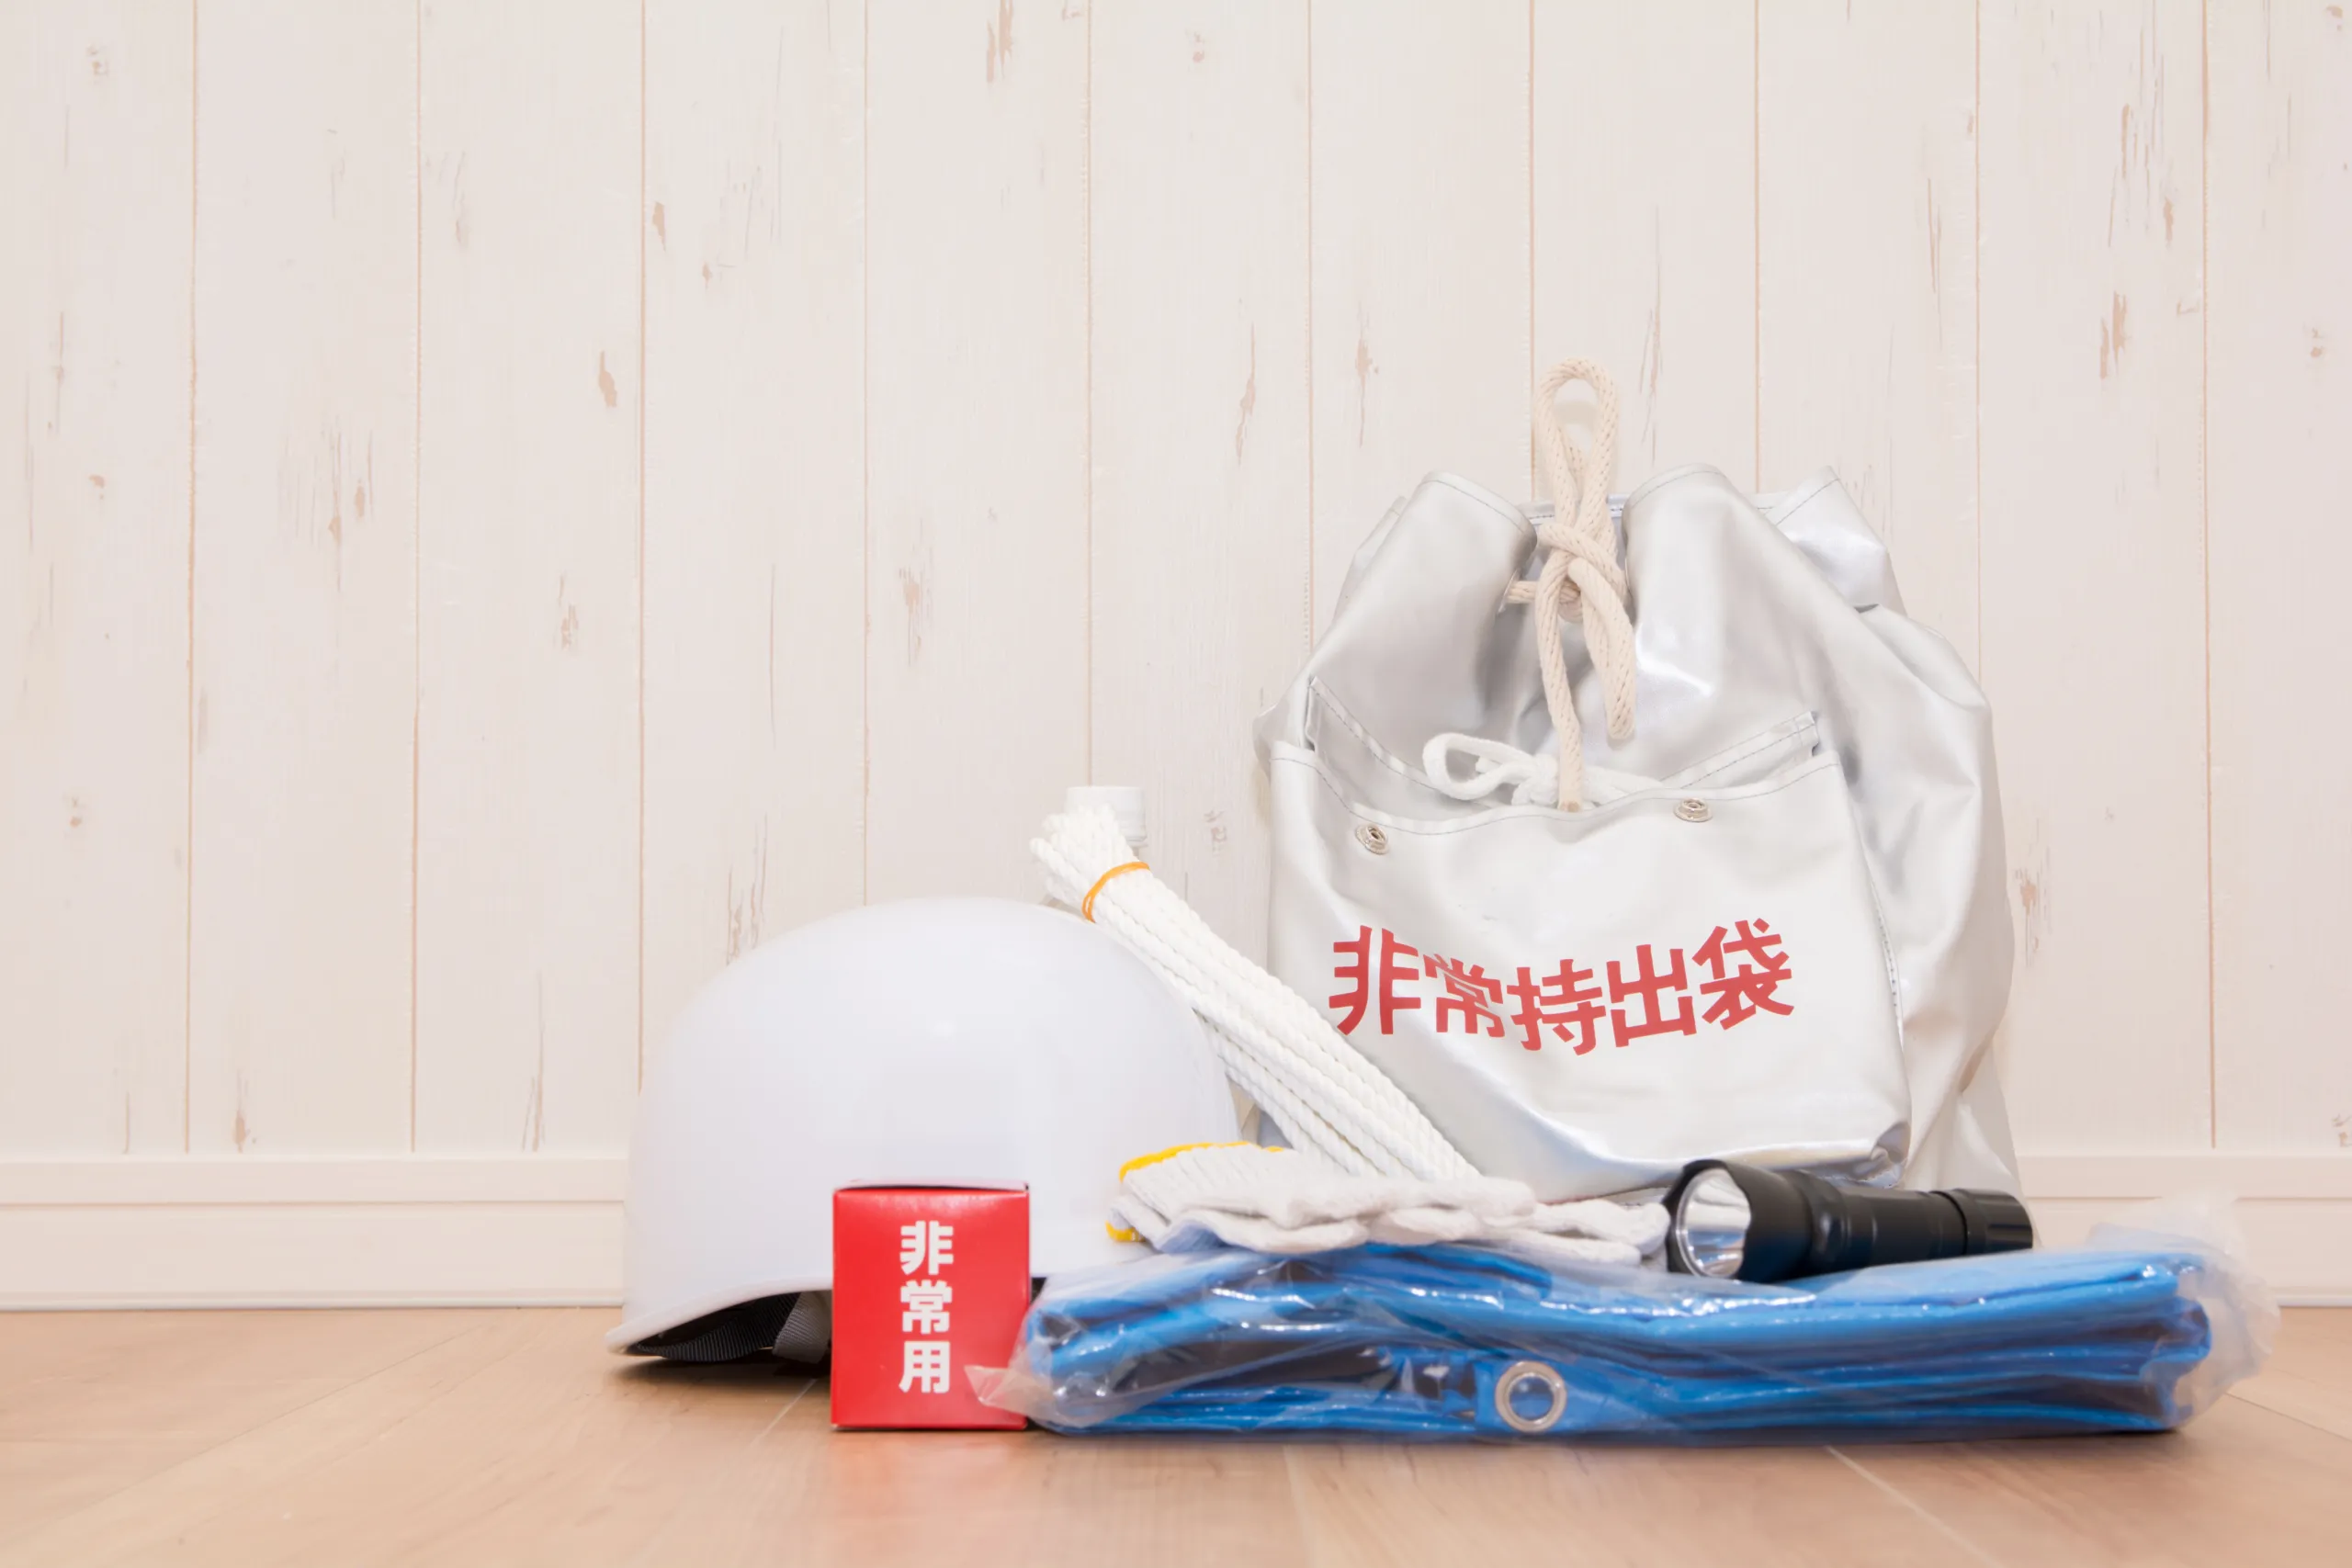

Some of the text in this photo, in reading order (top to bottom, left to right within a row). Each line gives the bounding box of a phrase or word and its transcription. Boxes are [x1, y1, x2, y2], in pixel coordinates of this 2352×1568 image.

[1328, 919, 1794, 1055] 非常持出袋
[899, 1220, 954, 1394] 非常用
